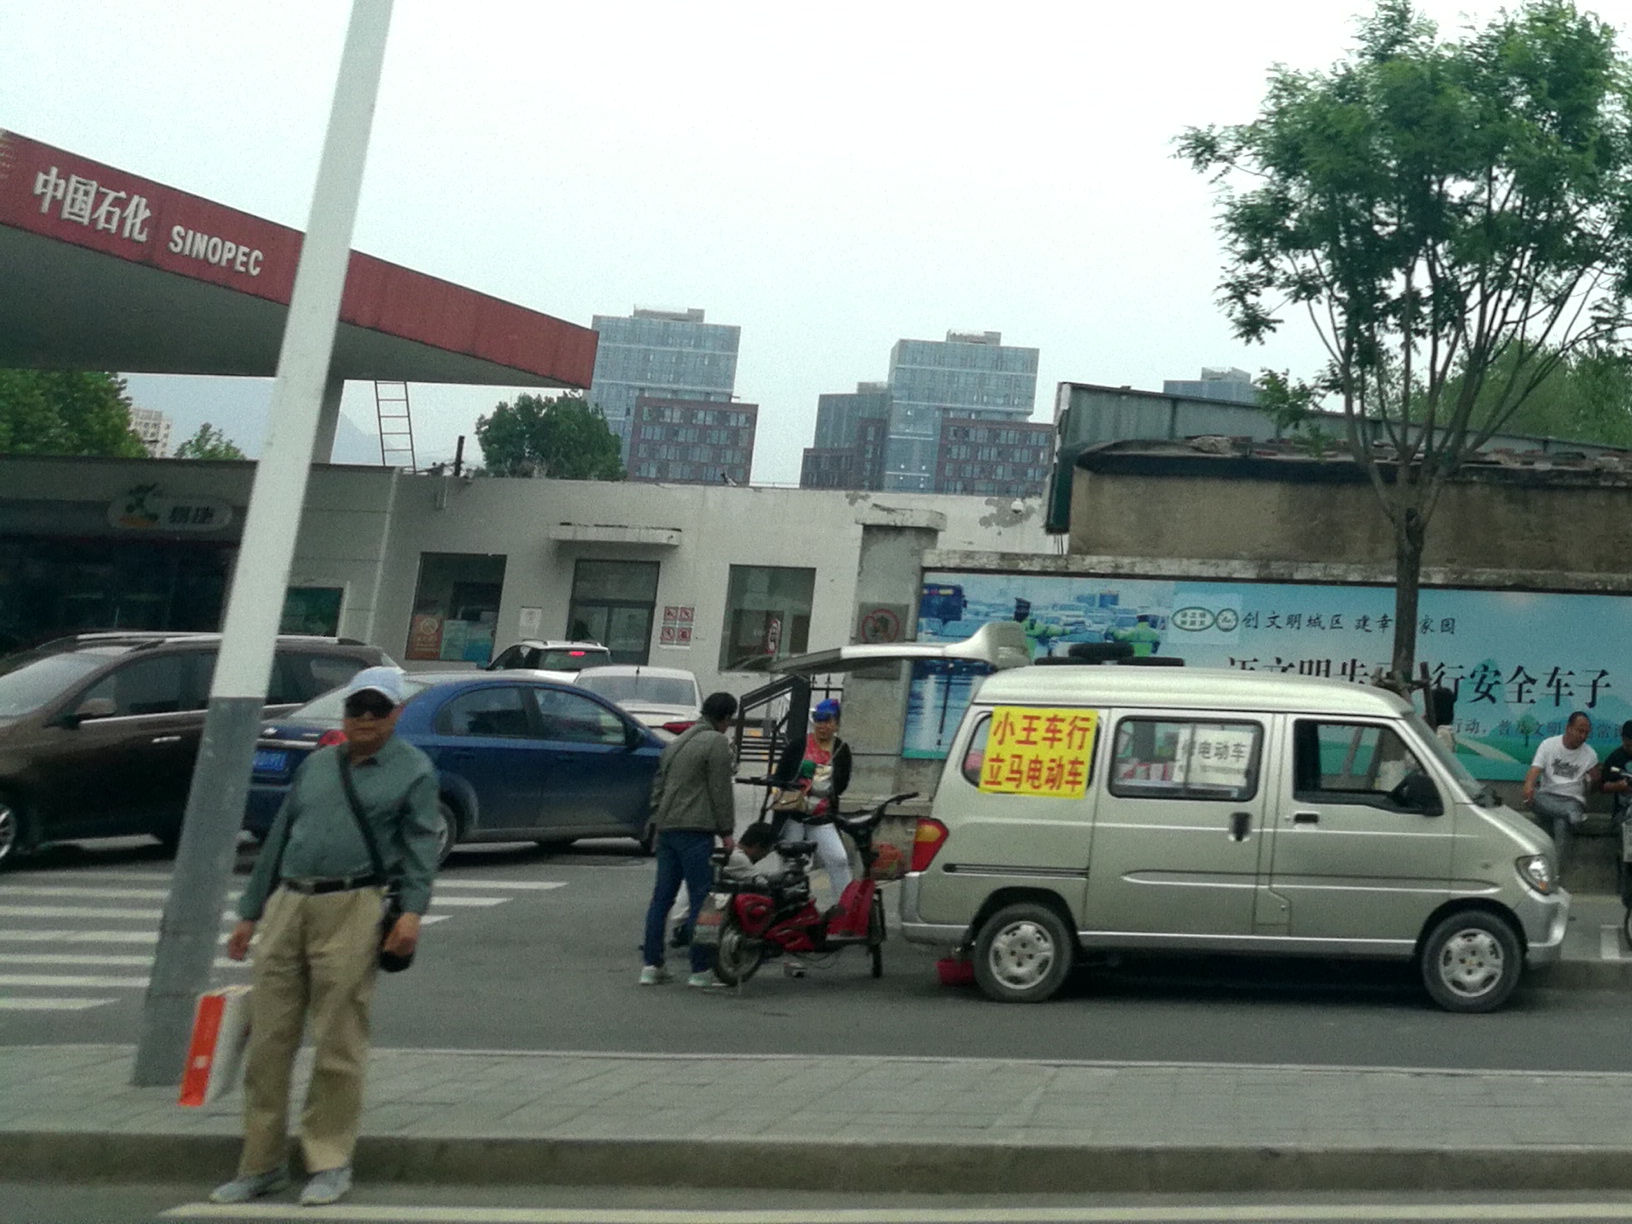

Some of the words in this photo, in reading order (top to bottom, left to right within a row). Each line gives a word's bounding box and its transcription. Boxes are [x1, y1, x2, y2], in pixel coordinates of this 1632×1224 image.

[33, 166, 151, 243] 中国石化
[168, 225, 264, 276] SINOPEC
[1241, 610, 1345, 631] 创文明城区
[1355, 615, 1456, 635] 建幸家园
[993, 711, 1091, 751] 小王车行
[984, 753, 1085, 792] 立马电动车
